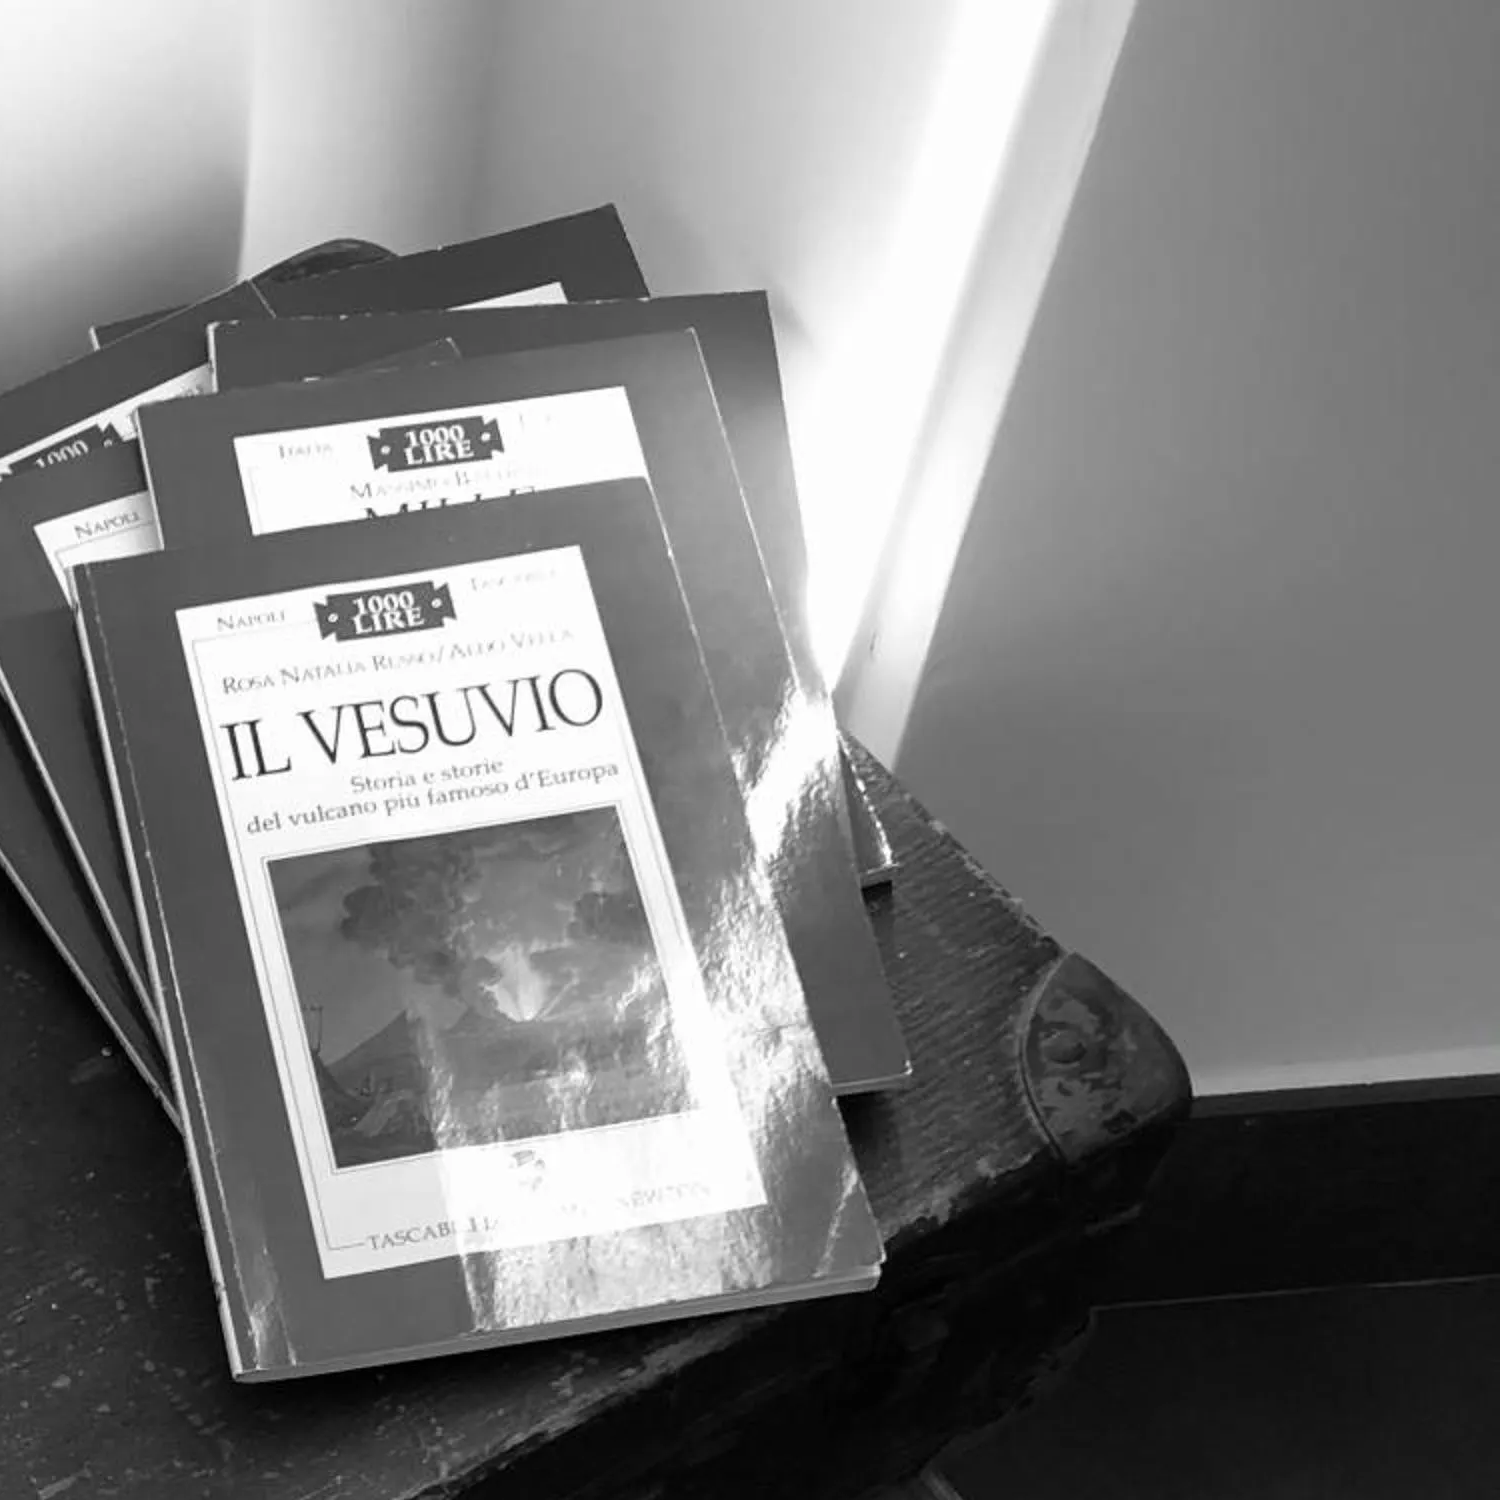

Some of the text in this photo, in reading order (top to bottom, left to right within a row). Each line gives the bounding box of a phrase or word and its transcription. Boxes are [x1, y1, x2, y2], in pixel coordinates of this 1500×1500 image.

[404, 424, 466, 448] 1000
[403, 440, 476, 466] LIRE
[352, 590, 416, 616] 1000
[352, 607, 426, 635] LIRE
[220, 667, 605, 782] IL VESUVIO
[350, 757, 504, 794] Storia e storie
[246, 811, 282, 835] del
[288, 799, 379, 828] vulcano
[427, 779, 510, 808] famoso
